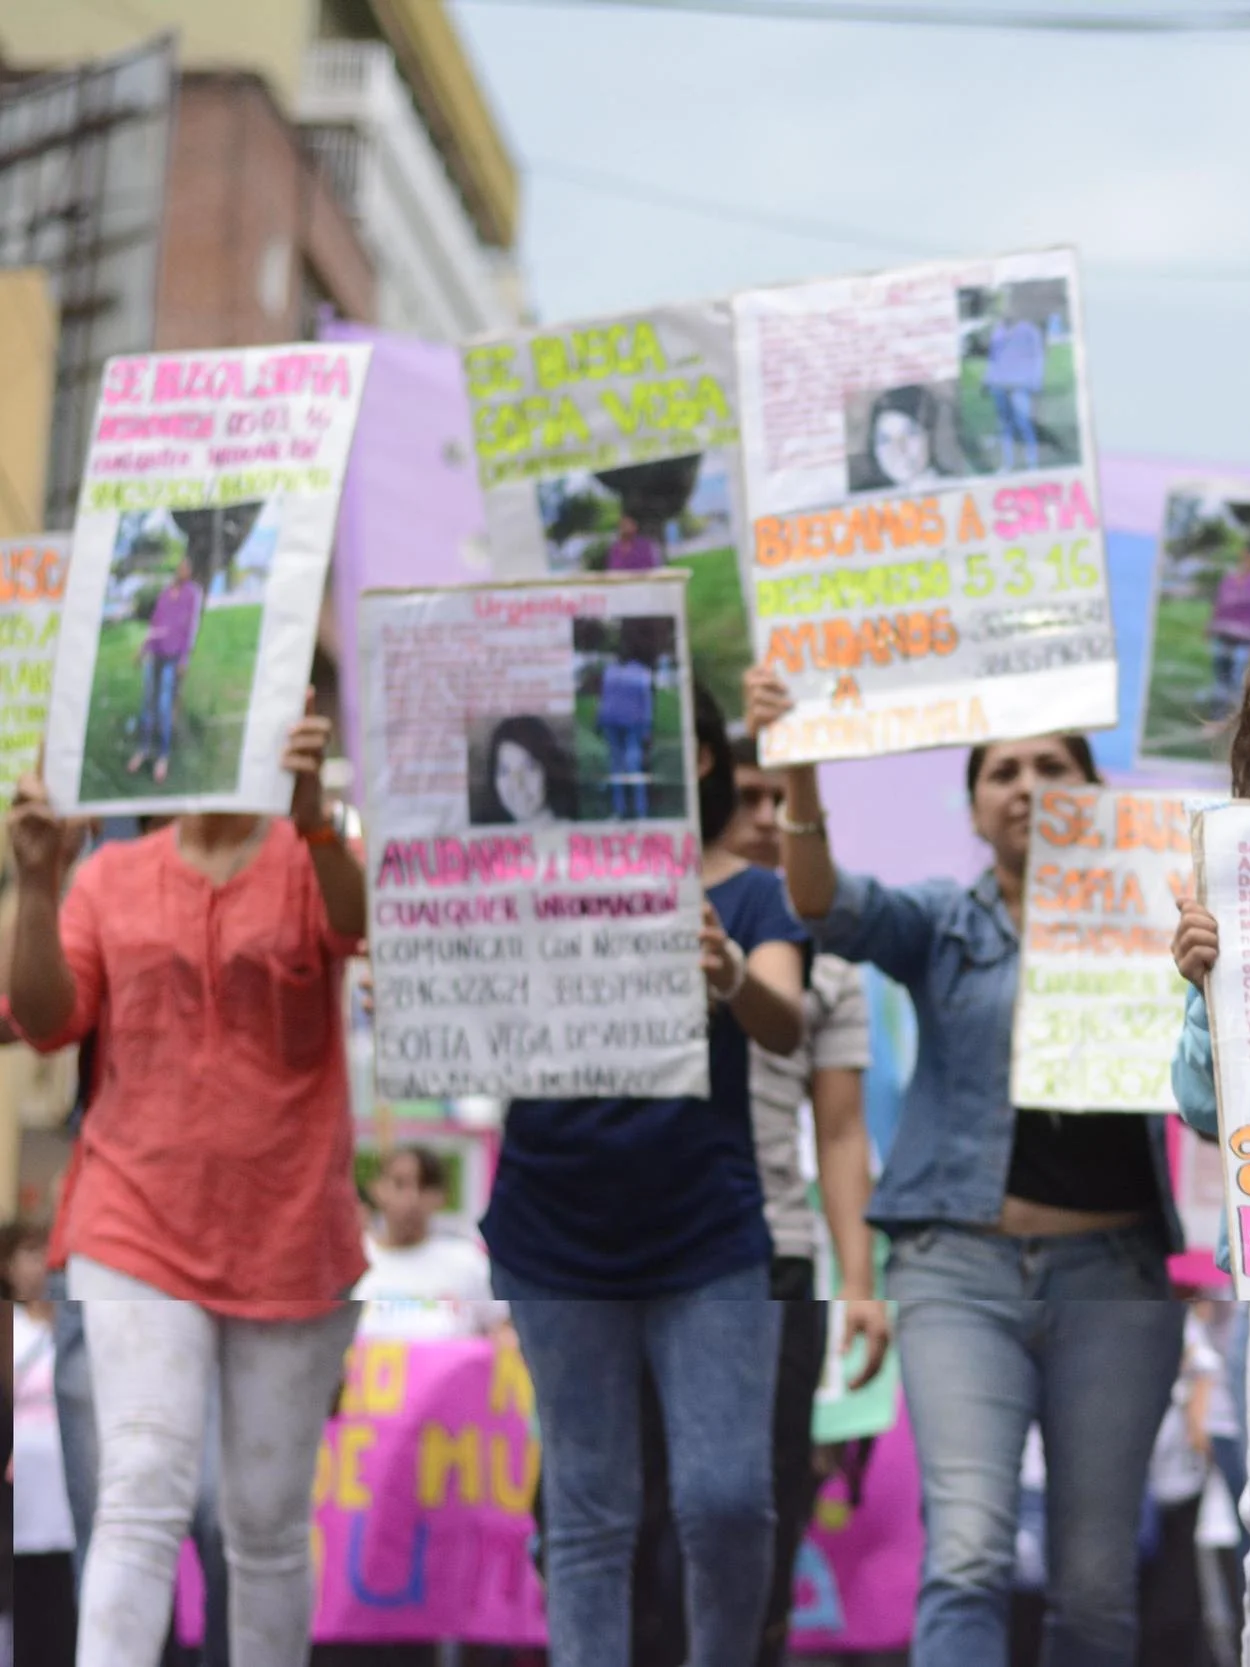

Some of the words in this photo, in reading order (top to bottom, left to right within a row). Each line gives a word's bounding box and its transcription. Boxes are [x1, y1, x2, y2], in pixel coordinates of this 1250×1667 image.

[465, 345, 522, 398] SE
[597, 374, 728, 434] VEGA
[752, 497, 943, 568] BUSCAMOS
[954, 492, 984, 544] A
[826, 673, 863, 711] A
[1039, 789, 1103, 848] SE
[1032, 864, 1147, 915] SOFIA
